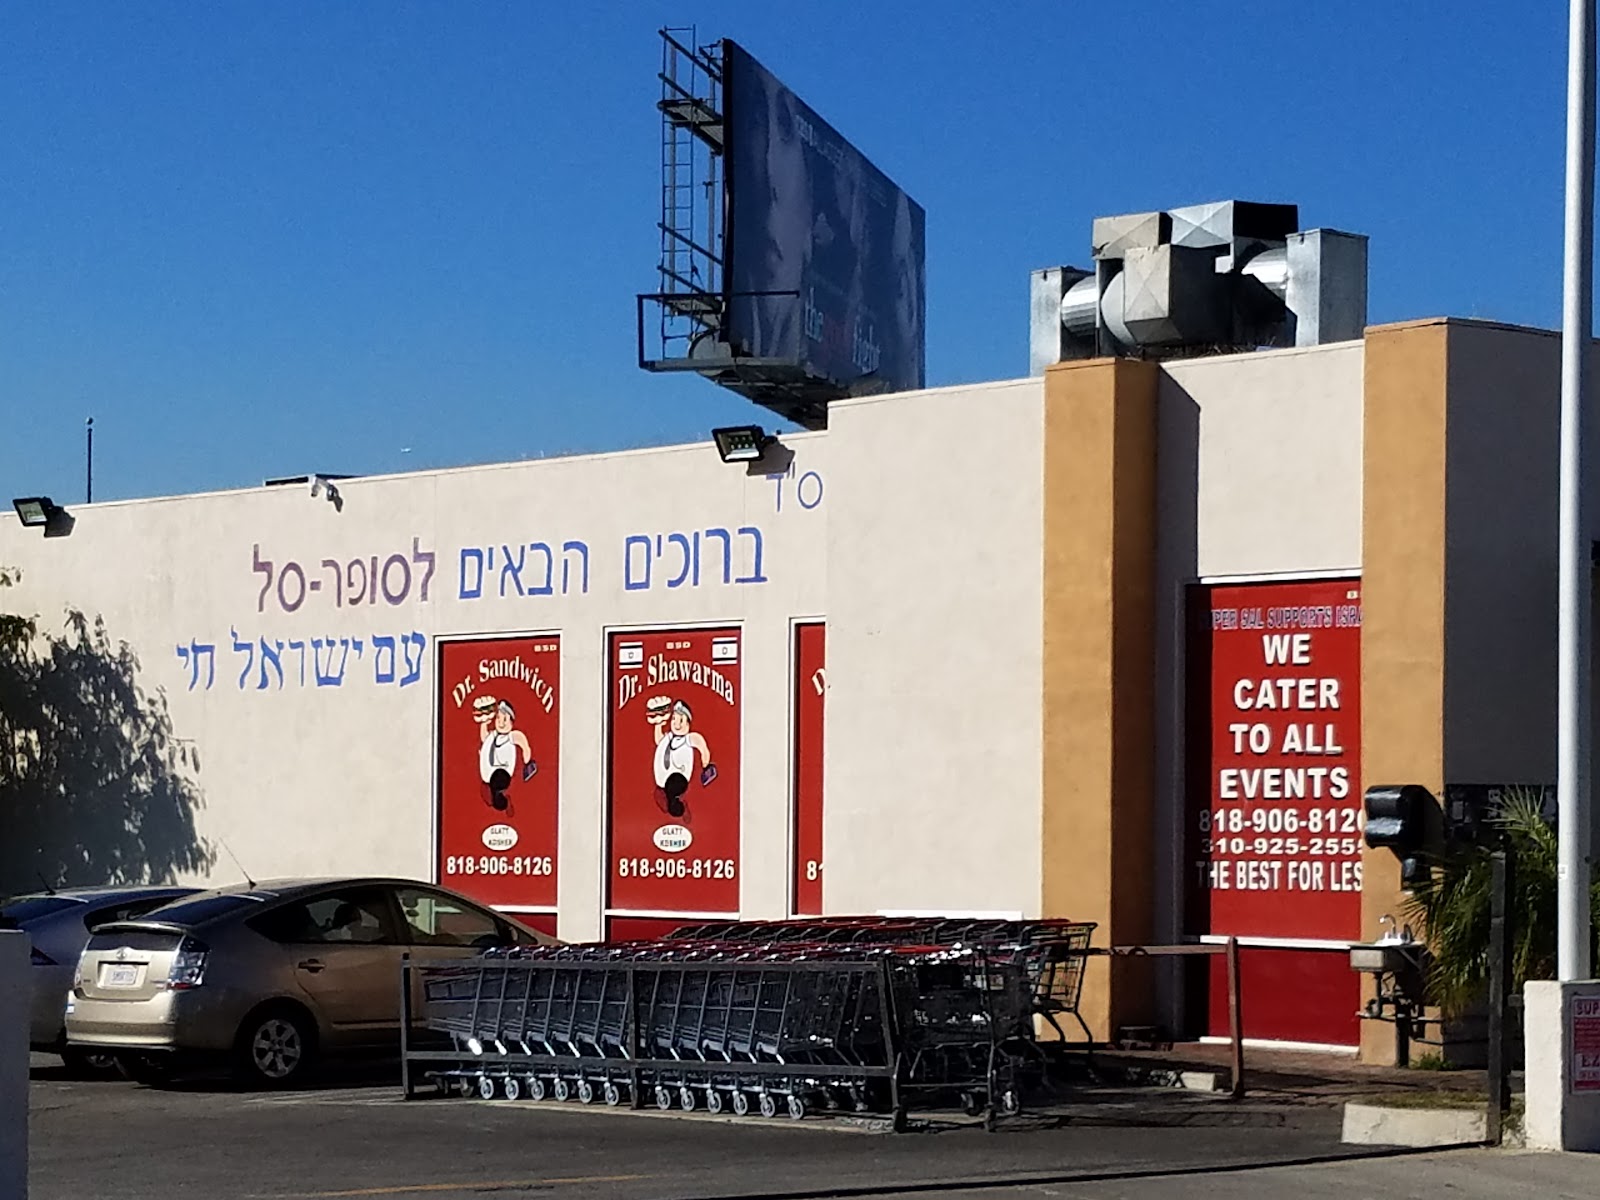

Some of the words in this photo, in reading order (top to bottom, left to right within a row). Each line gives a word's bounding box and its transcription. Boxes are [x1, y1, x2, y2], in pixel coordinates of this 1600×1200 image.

[458, 541, 589, 599] הבאים
[624, 527, 768, 590] ברוכים
[176, 637, 215, 691] חי
[231, 625, 363, 690] ישראל
[372, 630, 426, 687] עם
[1262, 634, 1311, 664] WE
[452, 675, 475, 708] Dr.
[479, 656, 553, 713] Sandwich
[618, 674, 642, 709] Dr.
[647, 653, 735, 705] Shawarma
[1234, 679, 1340, 709] CATER
[1229, 723, 1271, 753] TO
[1281, 723, 1344, 754] ALL
[1220, 767, 1349, 799] EVENTS
[447, 856, 552, 876] 818-906-8126
[619, 858, 735, 879] 818-906-8126
[1236, 860, 1282, 890] BEST
[1288, 860, 1324, 891] FOR
